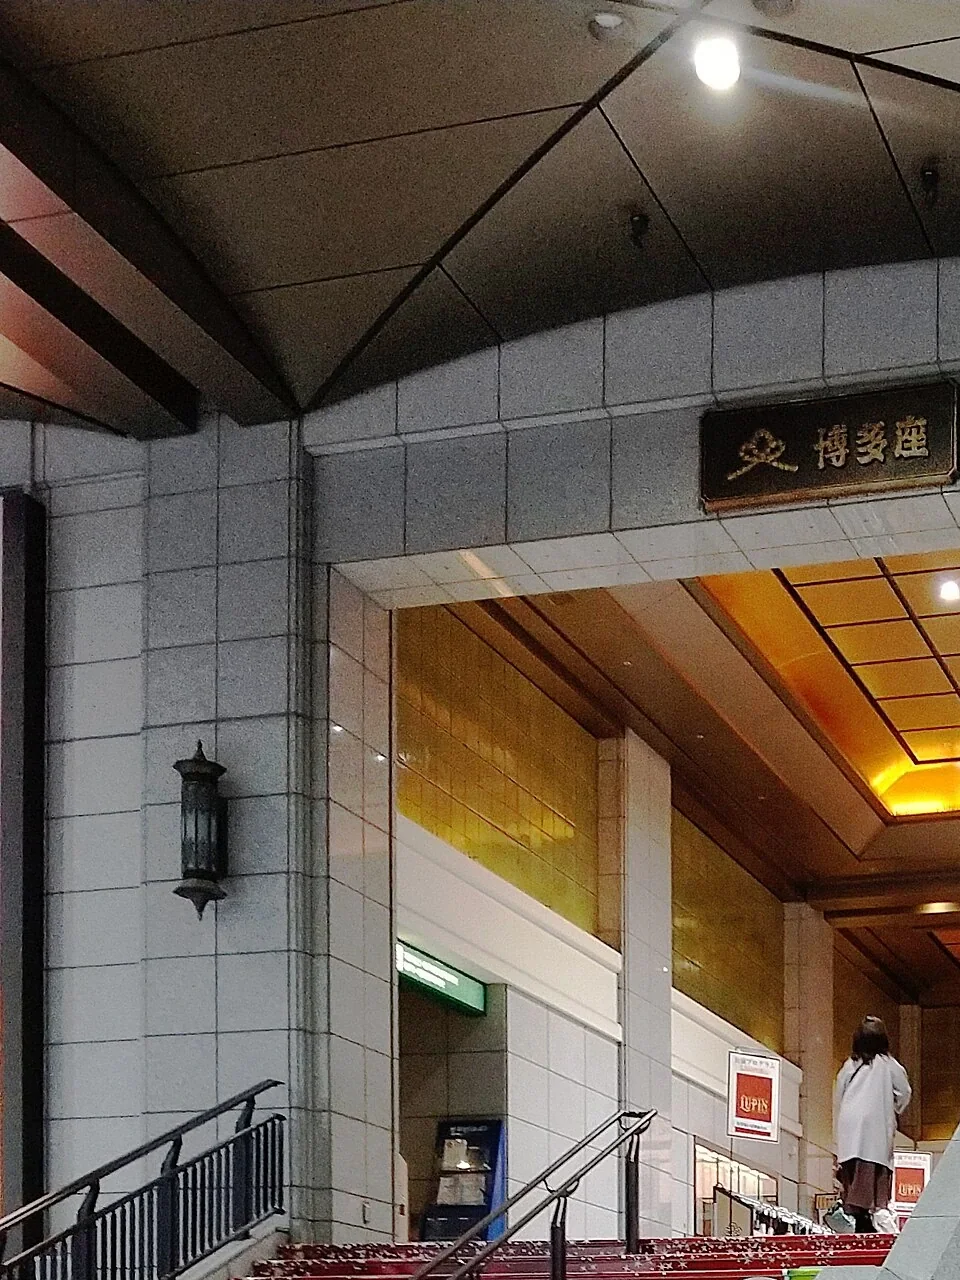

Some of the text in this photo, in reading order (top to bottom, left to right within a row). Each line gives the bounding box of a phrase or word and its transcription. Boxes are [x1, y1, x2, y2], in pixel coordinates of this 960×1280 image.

[814, 415, 930, 470] 博多座
[740, 1094, 769, 1114] LUPIN
